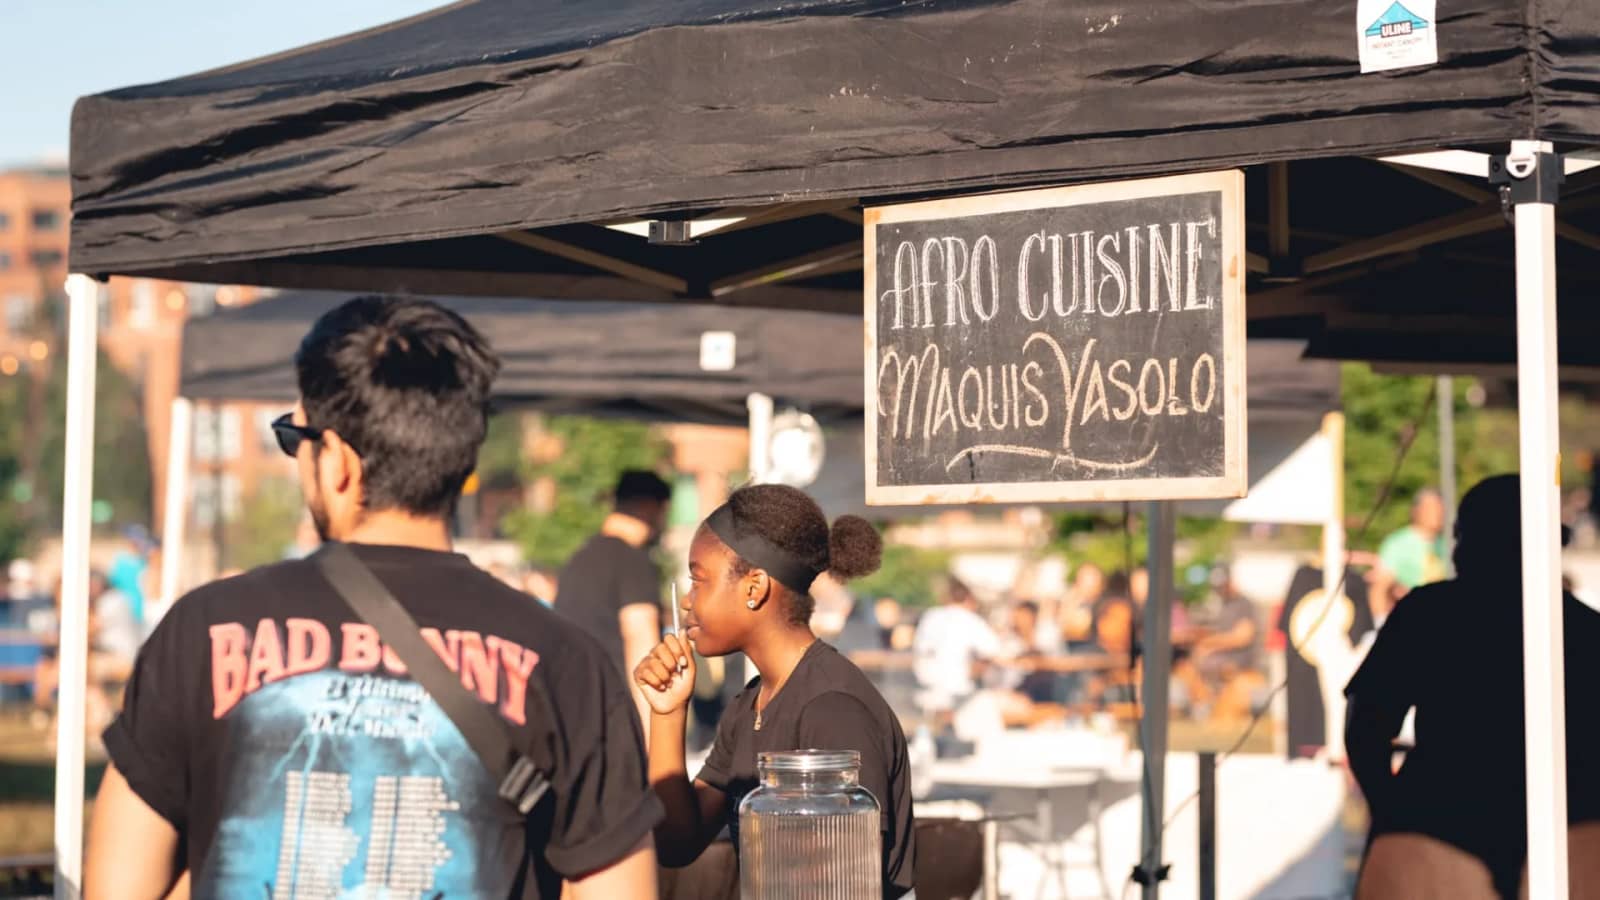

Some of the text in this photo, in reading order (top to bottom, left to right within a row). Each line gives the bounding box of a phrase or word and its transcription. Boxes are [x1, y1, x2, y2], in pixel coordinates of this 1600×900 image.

[1381, 22, 1412, 37] ULINE
[880, 216, 1217, 330] AFRO CUISINE
[877, 331, 1217, 450] MAQUIS YASOLO
[208, 617, 332, 720] BAD
